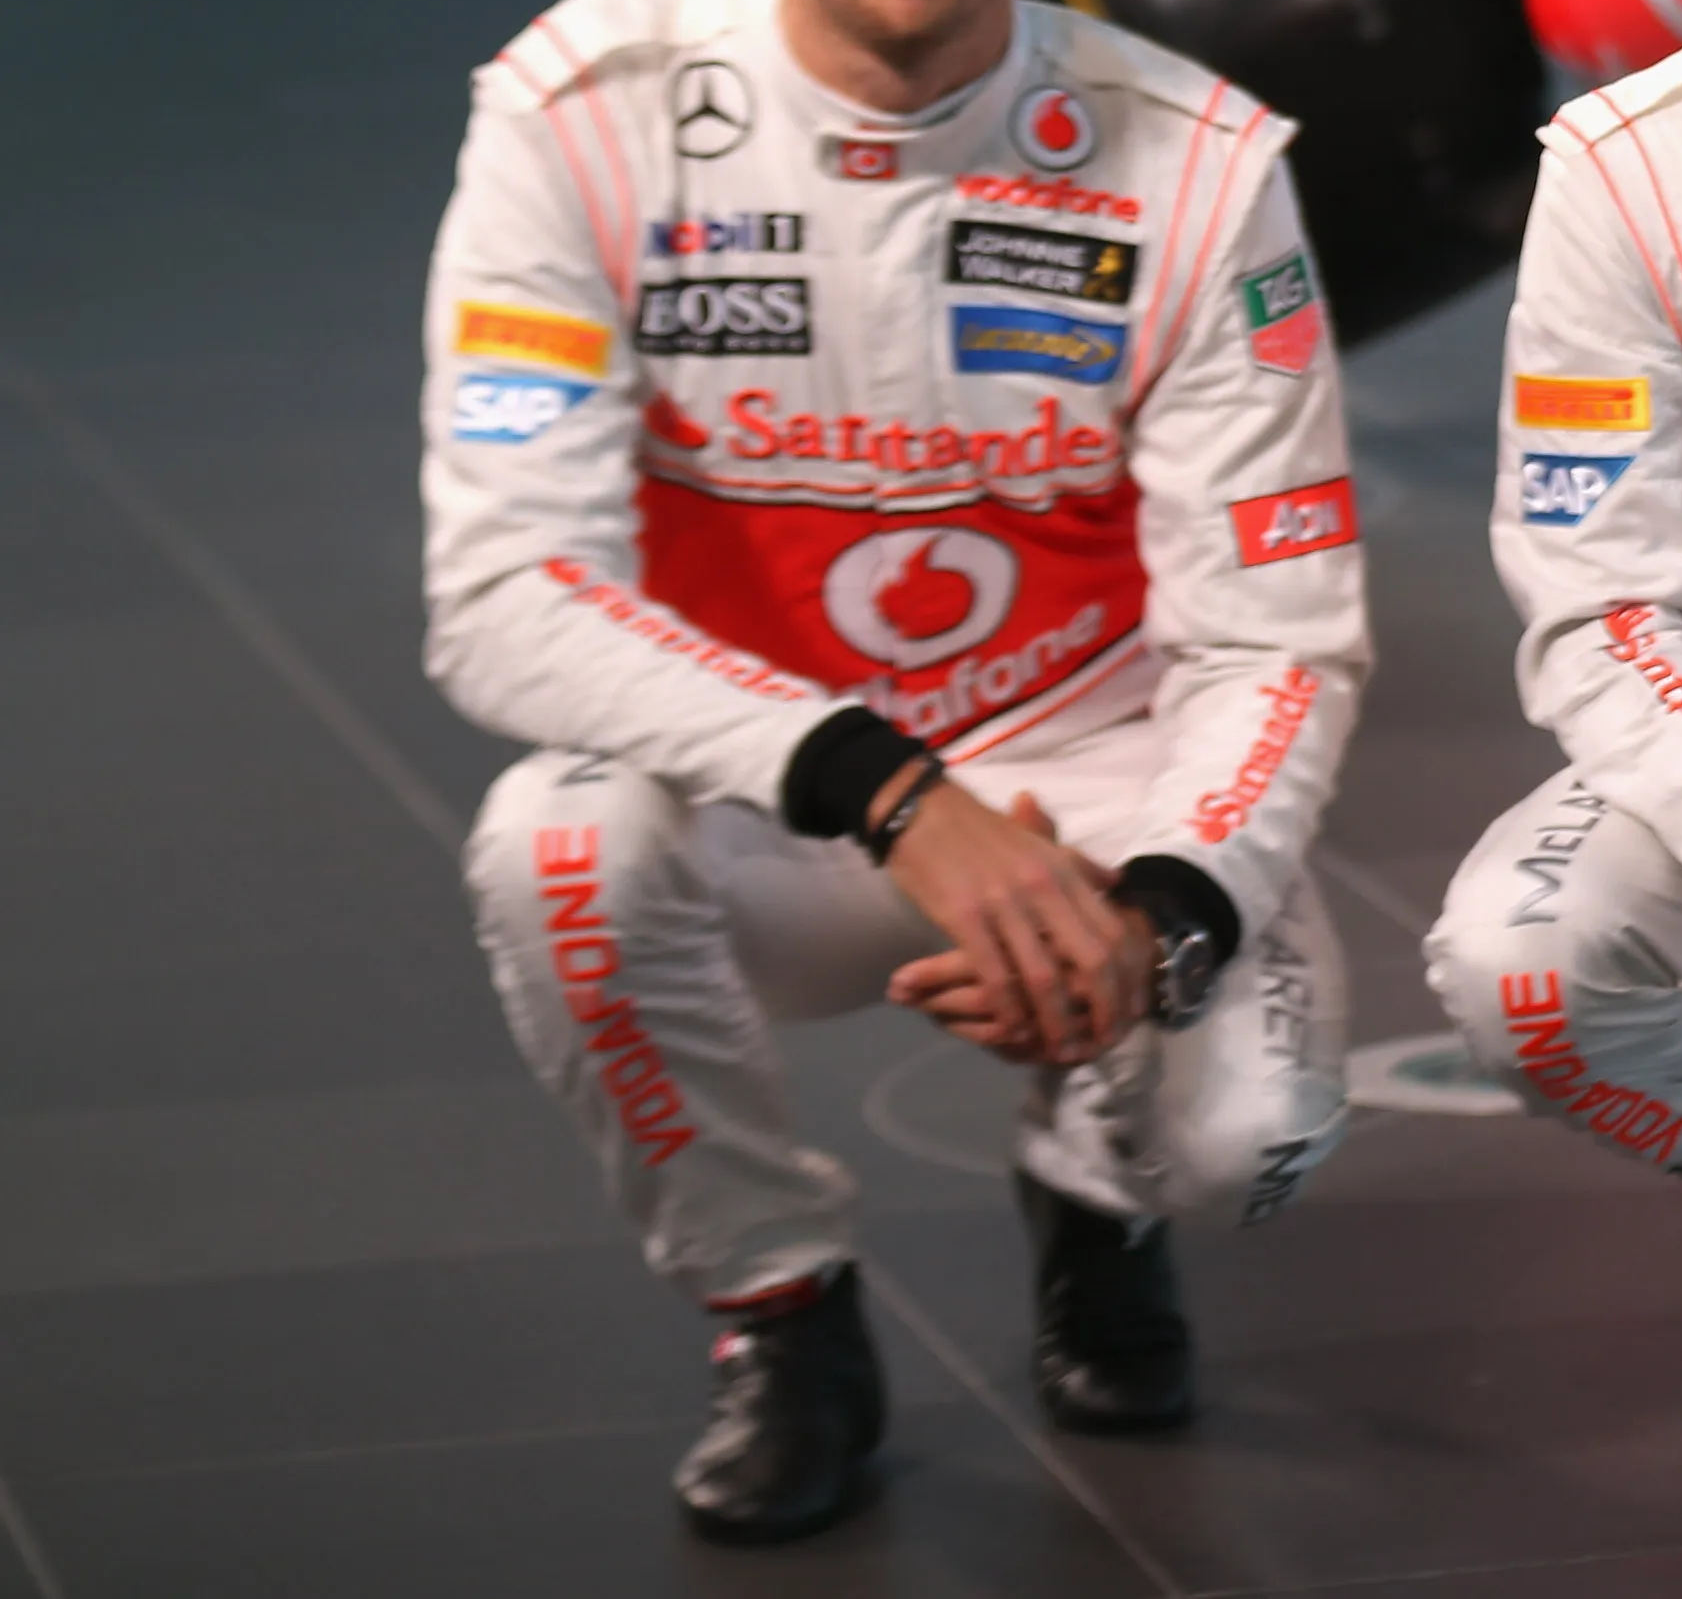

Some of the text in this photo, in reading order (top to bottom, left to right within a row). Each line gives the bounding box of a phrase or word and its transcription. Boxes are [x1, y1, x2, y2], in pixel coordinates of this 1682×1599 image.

[955, 173, 1142, 224] vodafone
[641, 282, 804, 335] BOSS
[452, 382, 566, 437] SAP
[726, 387, 1122, 477] Santande
[1522, 461, 1607, 515] SAP
[533, 822, 702, 1170] VODAFONE
